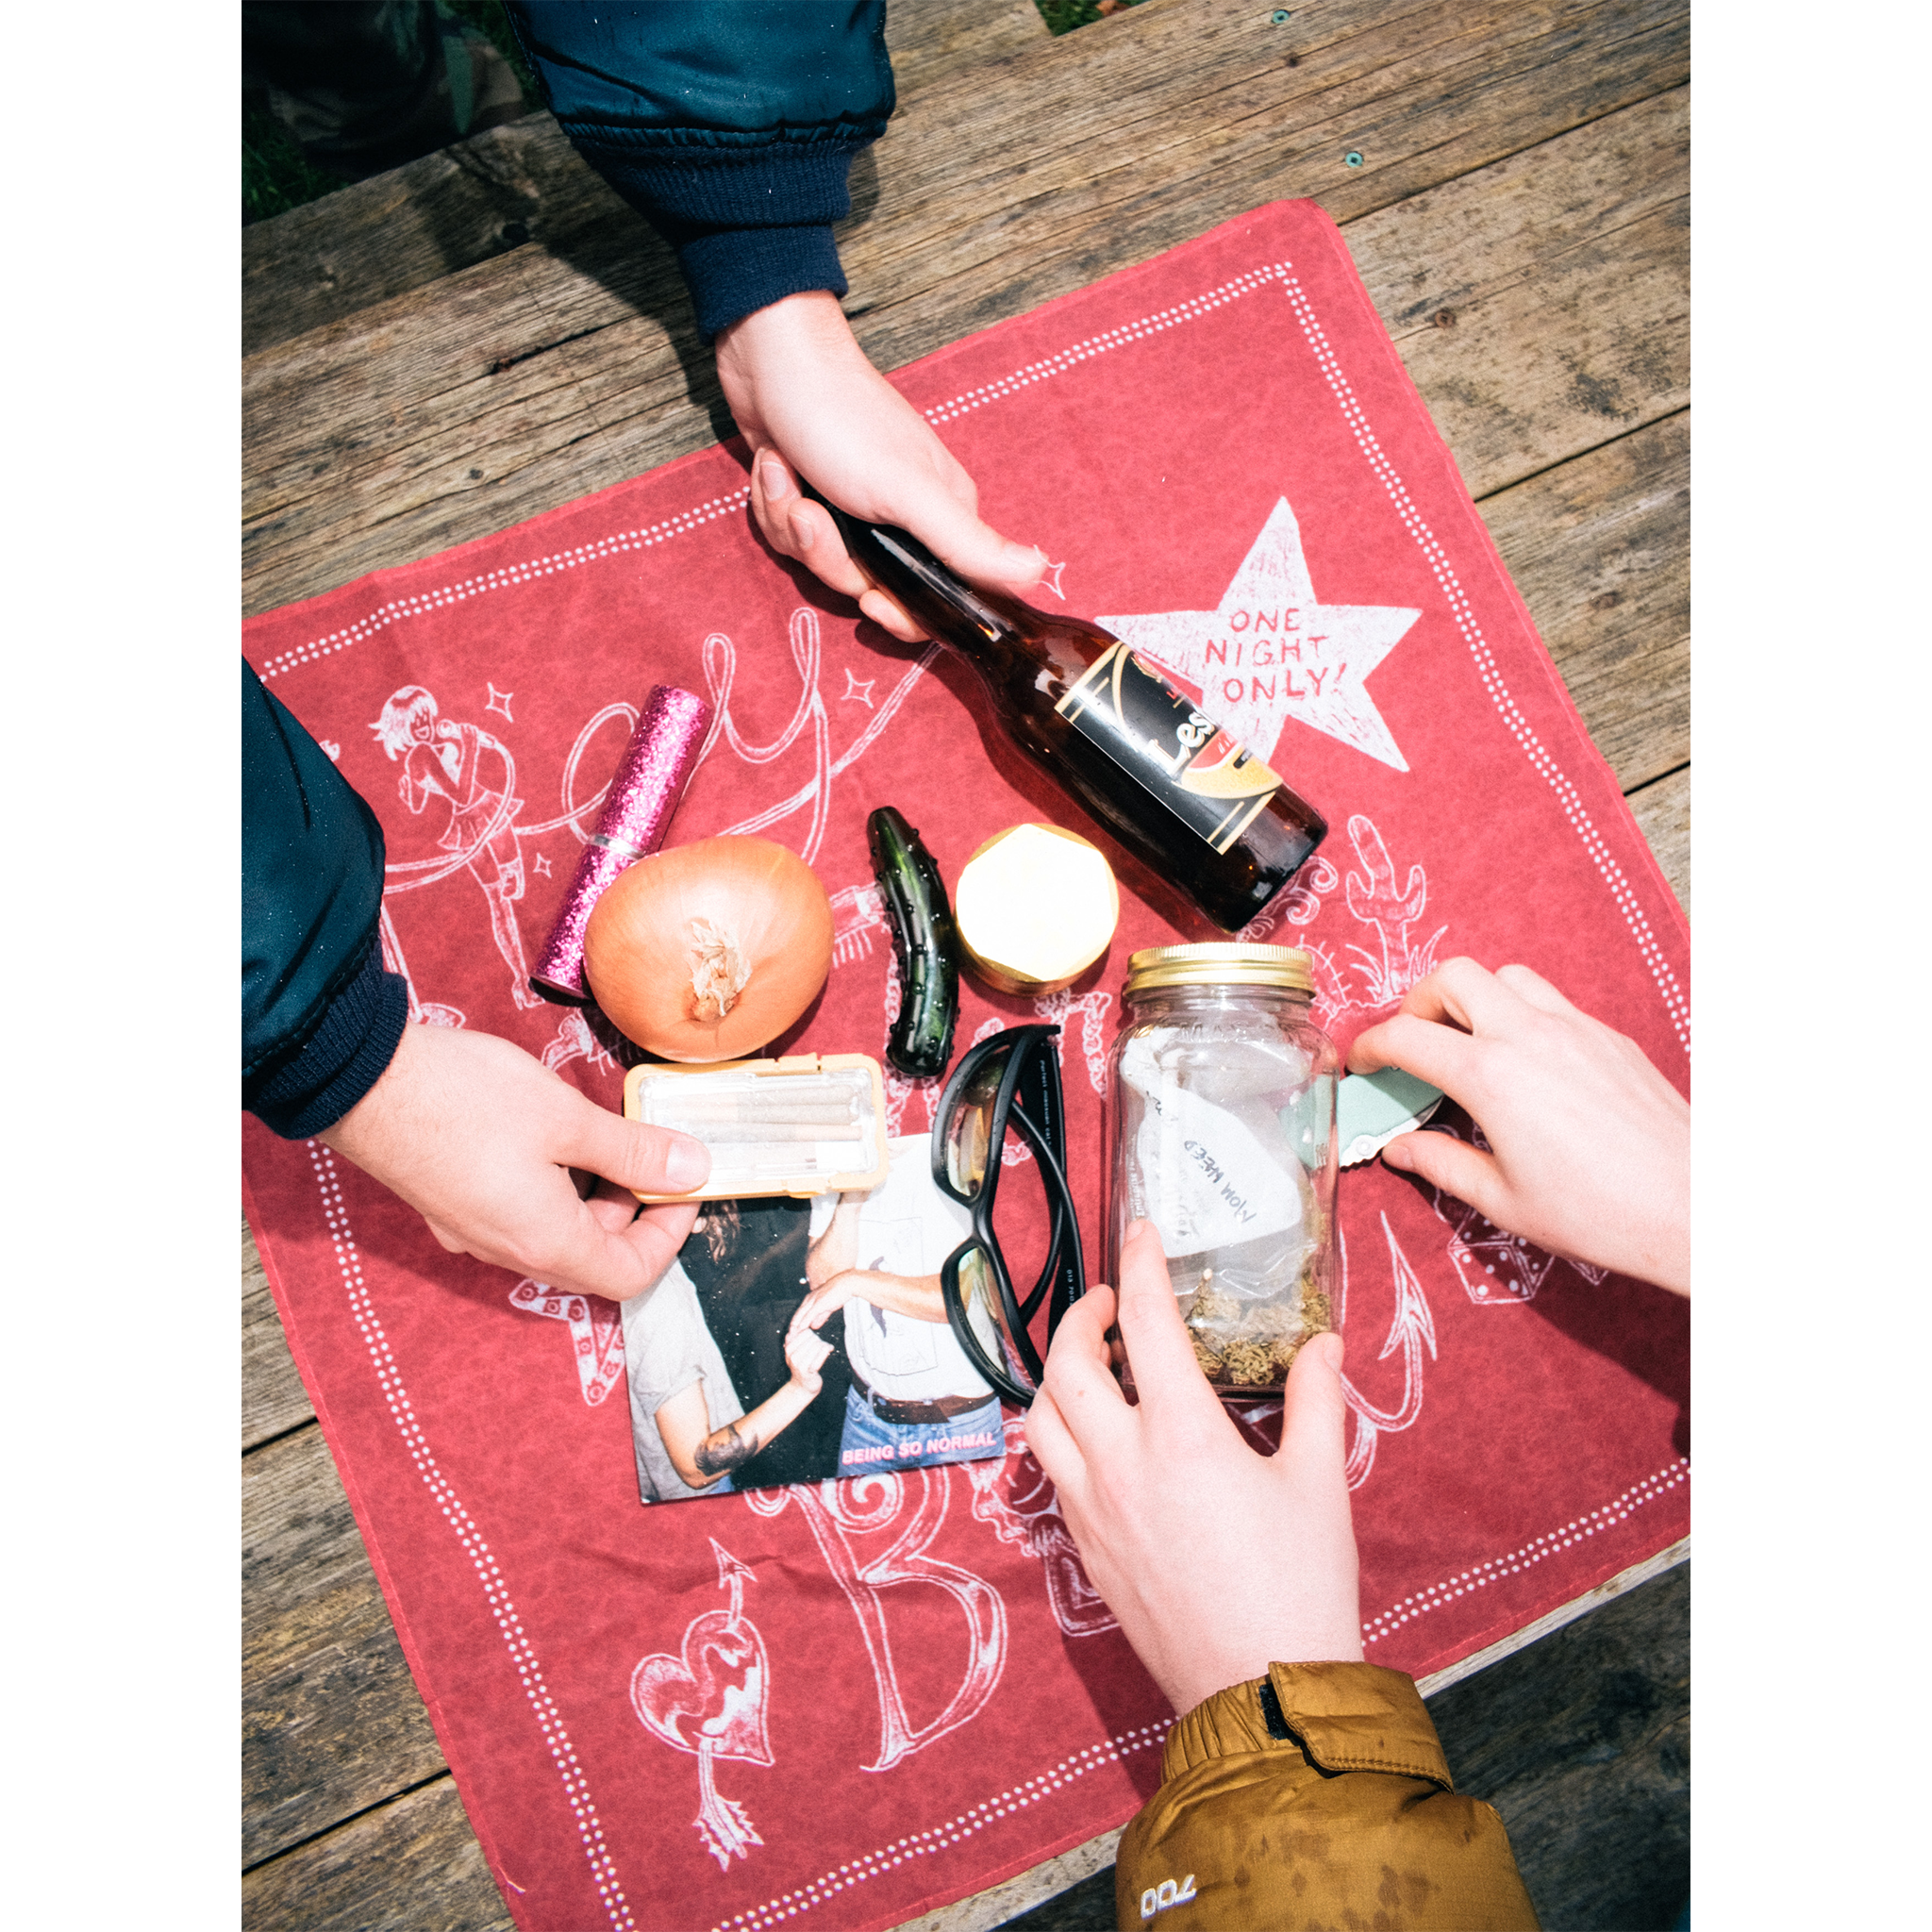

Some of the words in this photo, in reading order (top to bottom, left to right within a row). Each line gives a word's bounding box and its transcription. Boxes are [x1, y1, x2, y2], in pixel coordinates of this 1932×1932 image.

[1229, 607, 1301, 634] ONE
[1205, 634, 1330, 667] NIGHT
[1224, 661, 1348, 704] ONLY!
[842, 1444, 894, 1465] BEING
[898, 1441, 923, 1458] SO
[926, 1432, 997, 1455] NORMAL
[1141, 1874, 1197, 1921] 700
